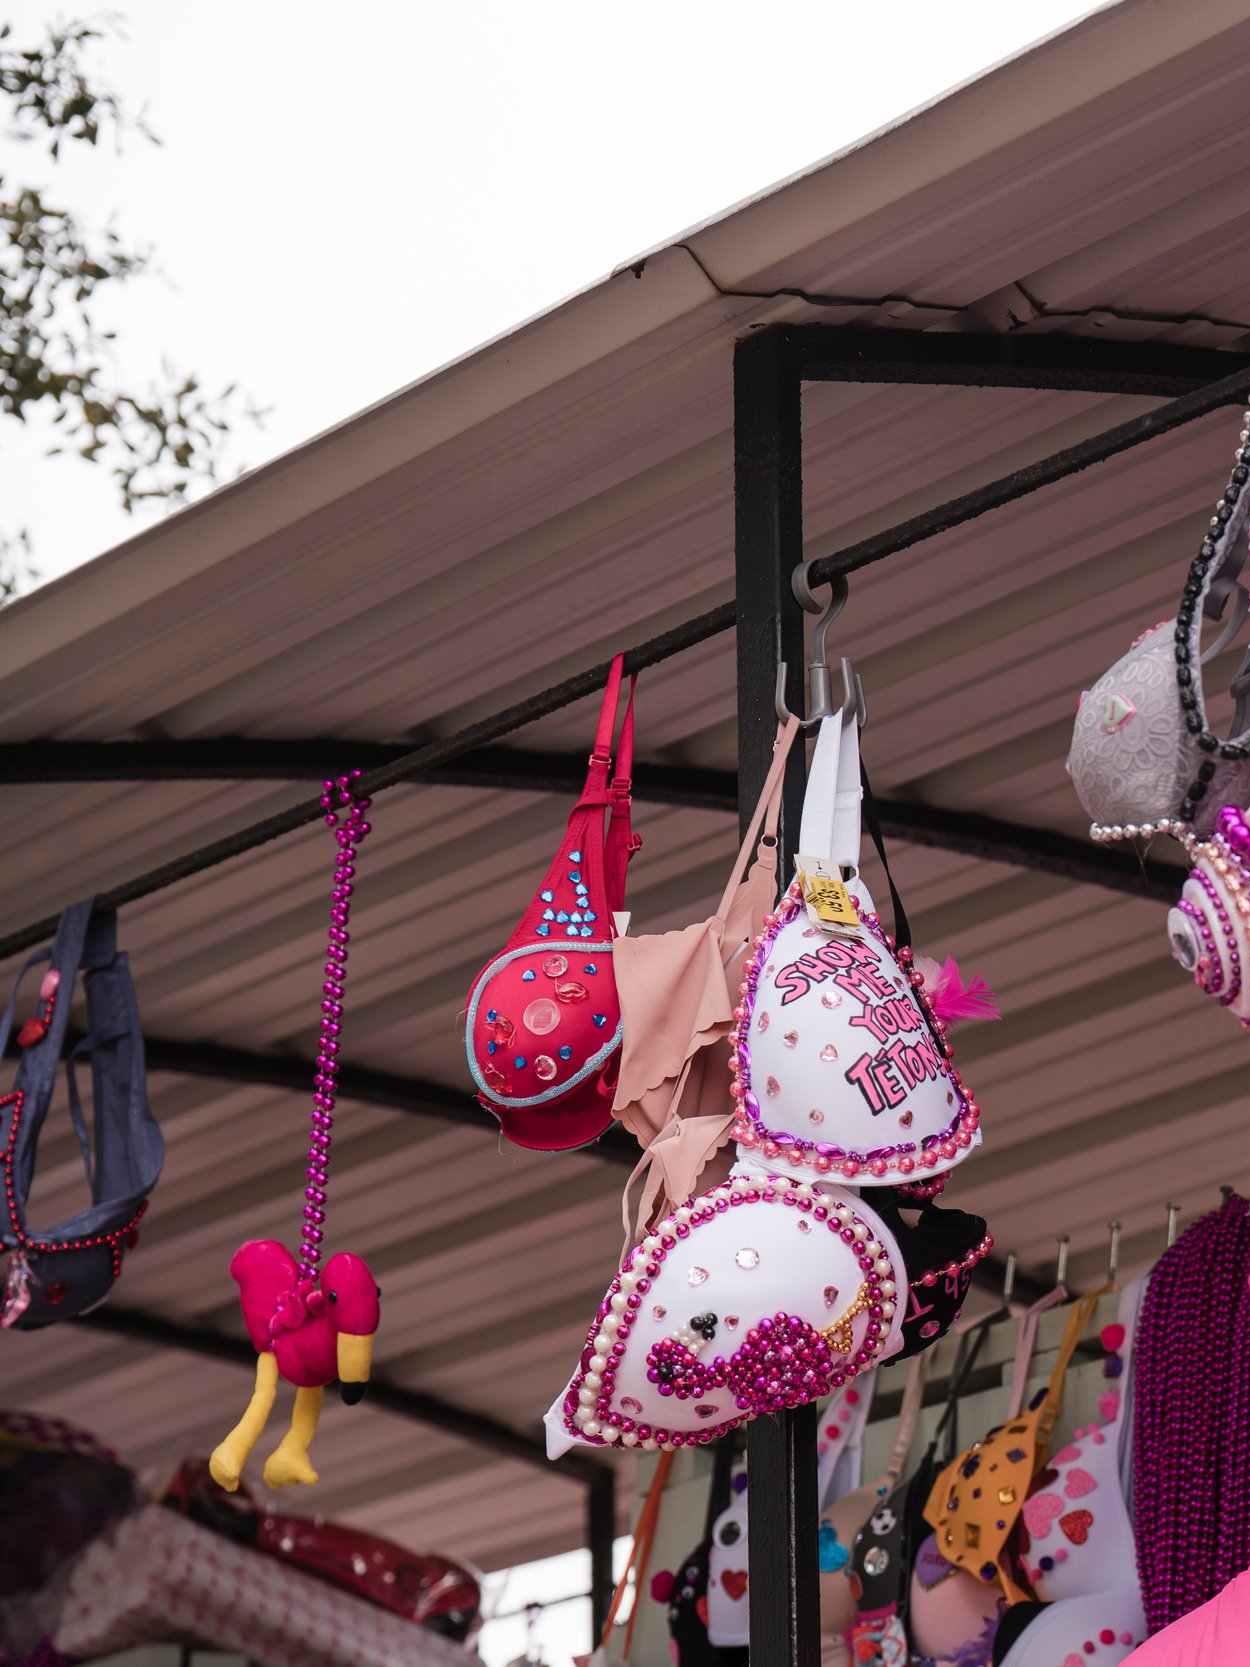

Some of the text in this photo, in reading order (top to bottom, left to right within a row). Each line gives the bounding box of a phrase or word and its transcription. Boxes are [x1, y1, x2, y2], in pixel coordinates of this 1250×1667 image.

[775, 940, 881, 1006] SHOW
[833, 962, 896, 1003] ME
[849, 994, 924, 1045] YOUR
